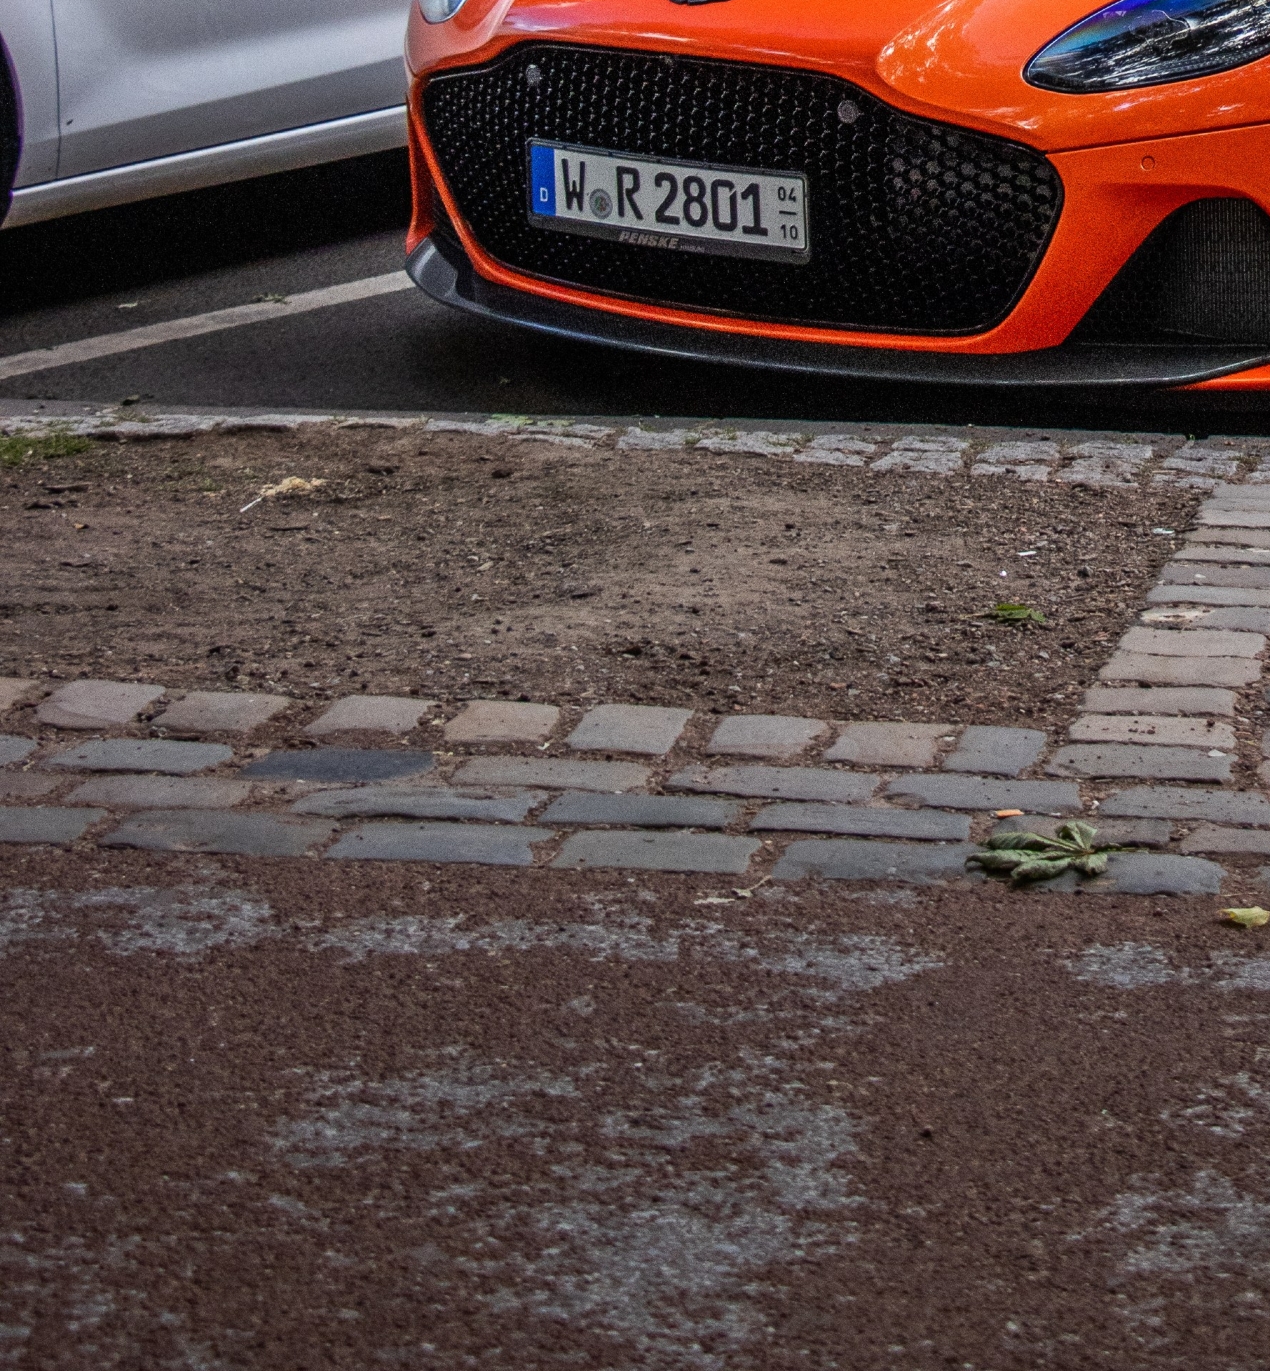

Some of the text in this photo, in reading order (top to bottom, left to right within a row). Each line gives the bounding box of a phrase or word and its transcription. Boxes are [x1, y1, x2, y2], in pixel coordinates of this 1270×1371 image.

[539, 187, 548, 202] D
[561, 158, 585, 211] W
[654, 171, 768, 237] 2801
[777, 186, 797, 202] 04
[619, 230, 680, 249] PENSKE
[780, 224, 798, 240] 10
